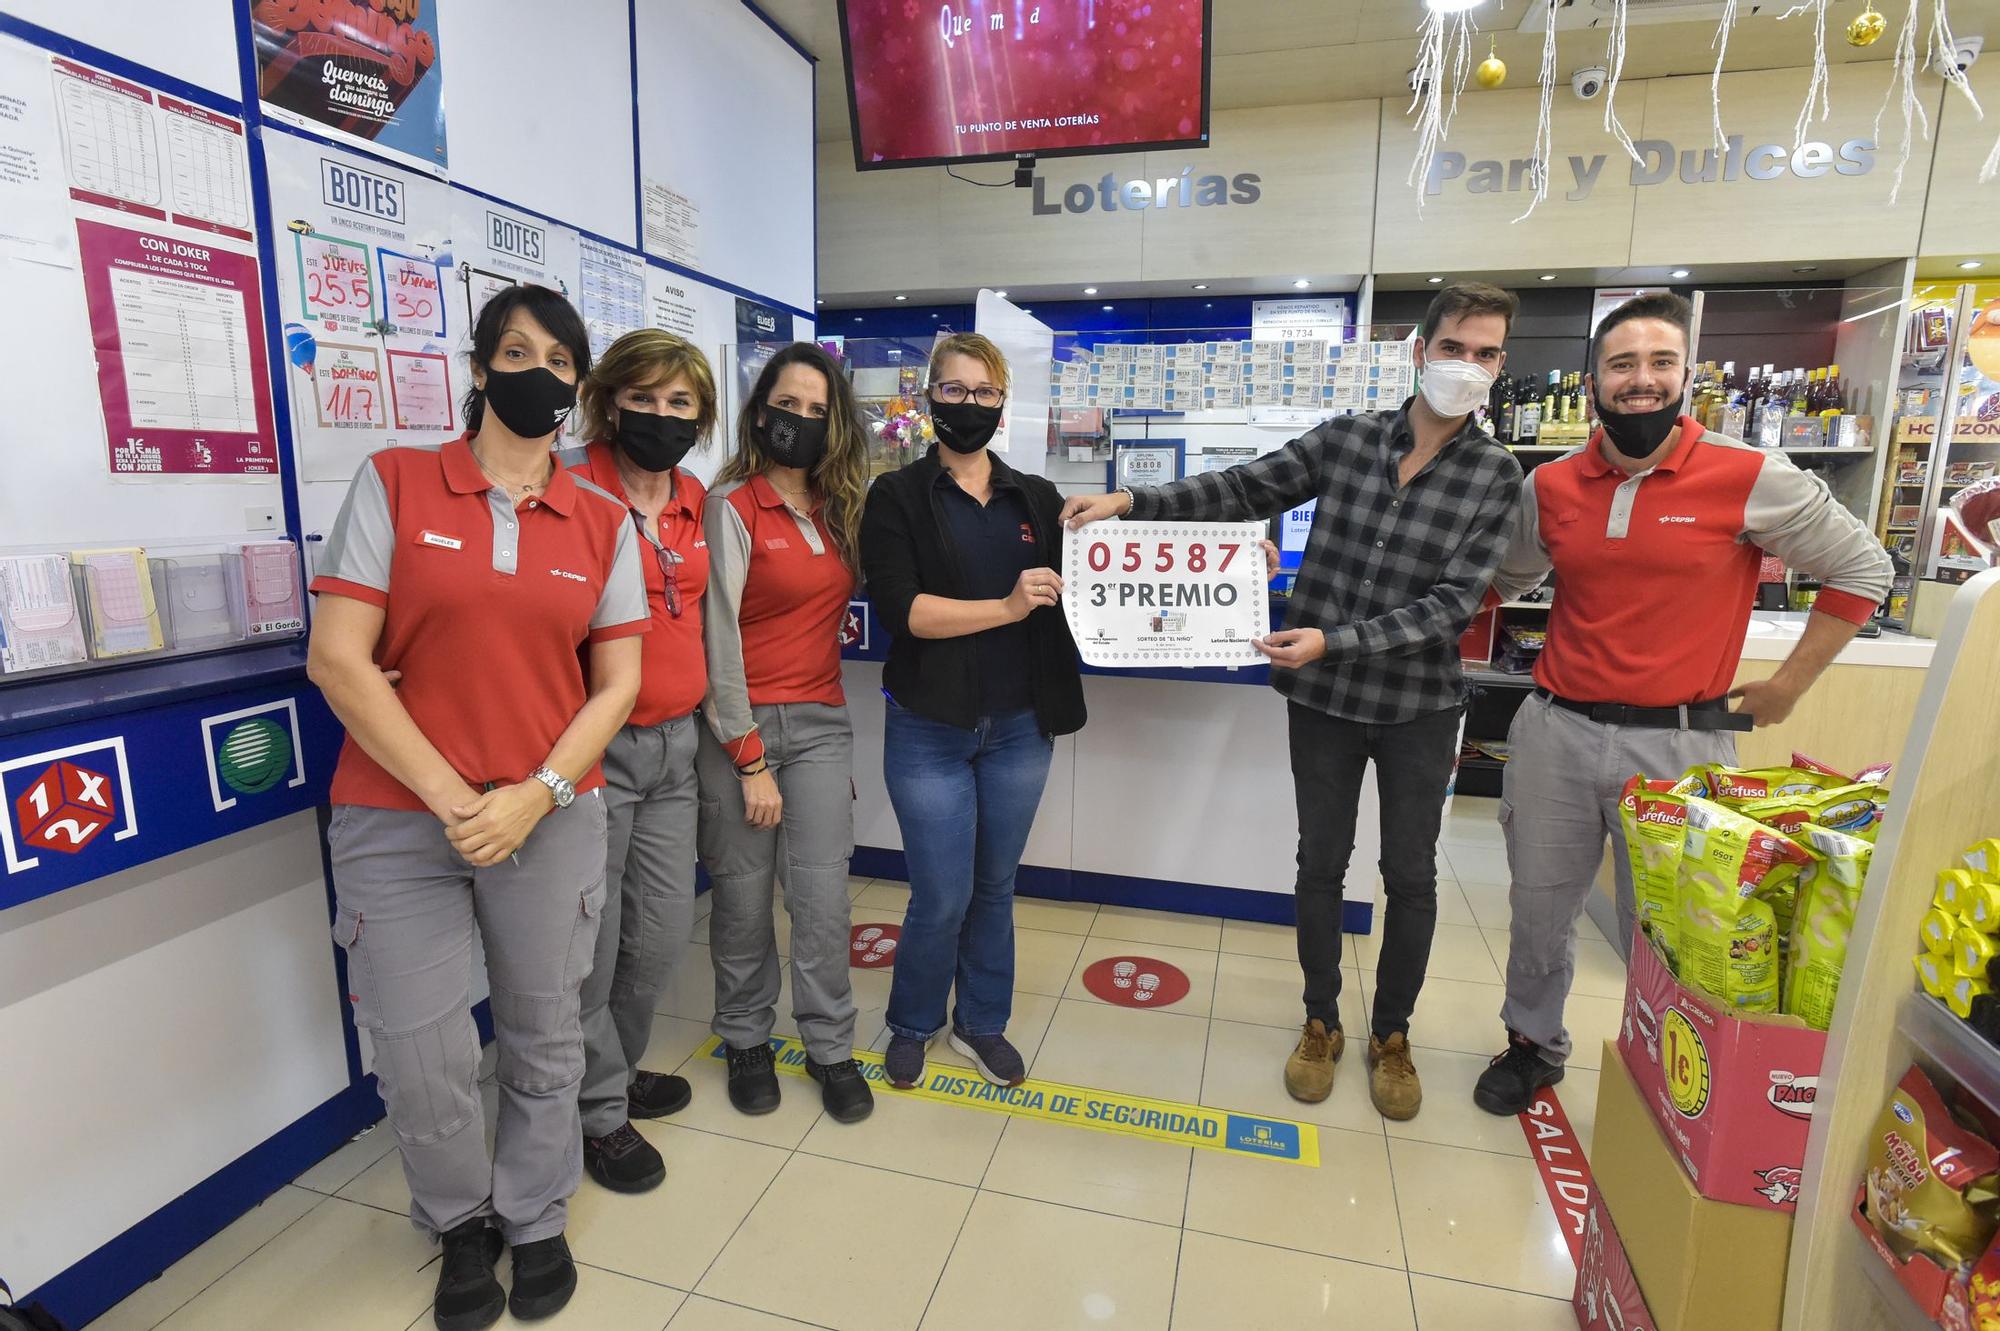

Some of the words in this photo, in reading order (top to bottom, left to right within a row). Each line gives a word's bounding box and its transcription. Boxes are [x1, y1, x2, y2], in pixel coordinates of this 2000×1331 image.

[941, 4, 972, 48] Que
[321, 59, 388, 92] Querrás
[329, 85, 395, 117] domingo
[955, 125, 967, 134] TU
[970, 122, 1001, 133] PUNTO
[1005, 121, 1017, 130] DE
[1020, 118, 1051, 129] VENTA
[1054, 113, 1099, 127] LOTERÍAS
[1425, 151, 1547, 196] Pan
[1566, 154, 1608, 202] y
[1629, 134, 1877, 187] Dulces
[330, 166, 397, 217] BOTES
[1033, 164, 1262, 216] Loterías
[139, 236, 169, 253] CON
[172, 245, 211, 262] JOKER
[493, 218, 540, 259] BOTES
[114, 258, 149, 270] COMPRUEBA
[160, 266, 183, 277] PREMIOS
[195, 273, 215, 282] REPARTE
[221, 278, 235, 286] JOKER
[152, 255, 162, 264] DE
[163, 256, 183, 268] CADA
[190, 262, 208, 273] TOCA
[306, 258, 318, 267] ESTE
[308, 272, 371, 308] 25.5
[387, 273, 397, 282] ESTE
[665, 285, 685, 298] AVISO
[320, 312, 341, 321] MILLONES
[347, 315, 361, 324] EUROS
[395, 292, 433, 318] 30
[319, 369, 330, 378] ESTE
[334, 421, 353, 429] MILLONES
[115, 447, 130, 455] POR
[144, 446, 160, 454] MÁS
[116, 463, 134, 471] CON
[136, 464, 163, 472] JOKER
[1088, 541, 1241, 573] 05587
[562, 571, 587, 582] CEPSA
[1119, 583, 1238, 607] PREMIO
[265, 623, 273, 632] El
[275, 620, 301, 631] Gordo
[29, 782, 50, 819] 1
[1716, 784, 1767, 798] Grefusa
[43, 818, 99, 845] 2
[931, 1075, 1044, 1111] DISTANCIA
[1048, 1095, 1079, 1117] DE
[1084, 1100, 1218, 1139] SEGURIDAD
[1240, 1135, 1286, 1149] LOTERÍAS
[1884, 1131, 1928, 1185] Marbú
[1885, 1149, 1917, 1192] Dorada
[1931, 1146, 1963, 1176] 1€
